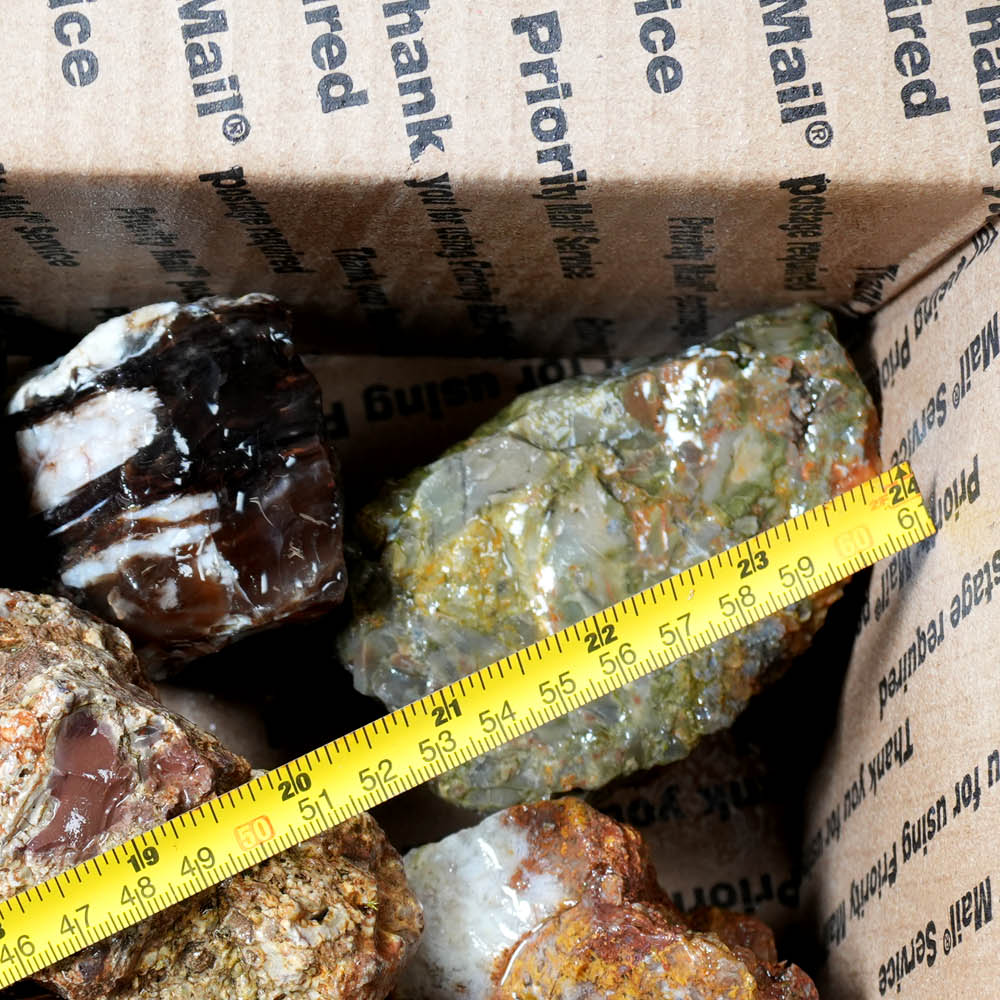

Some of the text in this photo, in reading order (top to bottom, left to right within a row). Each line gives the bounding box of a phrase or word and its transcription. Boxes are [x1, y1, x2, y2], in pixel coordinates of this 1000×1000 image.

[177, 0, 251, 145] Mail®
[510, 10, 588, 201] Priority
[757, 0, 834, 149] Mail®
[403, 172, 455, 205] you
[951, 311, 1000, 410] Mail®
[127, 845, 160, 873] 19
[277, 773, 312, 802] 20
[431, 698, 463, 728] 21
[584, 624, 619, 654] 22
[737, 551, 770, 580] 23
[889, 477, 921, 505] 24
[878, 610, 945, 723] required
[0, 935, 36, 965] 46
[60, 904, 92, 936] 47
[120, 875, 156, 906] 48
[180, 846, 216, 879] 49
[237, 816, 273, 848] 50
[299, 788, 334, 821] 51
[359, 759, 398, 792] 52
[418, 730, 457, 763] 53
[478, 700, 517, 734] 54
[539, 671, 577, 705] 55
[598, 642, 637, 676] 56
[658, 613, 692, 647] 57
[718, 584, 756, 617] 58
[778, 556, 816, 588] 59
[868, 717, 914, 797] Thank
[952, 765, 982, 820] for
[850, 841, 898, 922] Priority
[902, 794, 948, 865] using
[878, 875, 994, 997] Mail® Service
